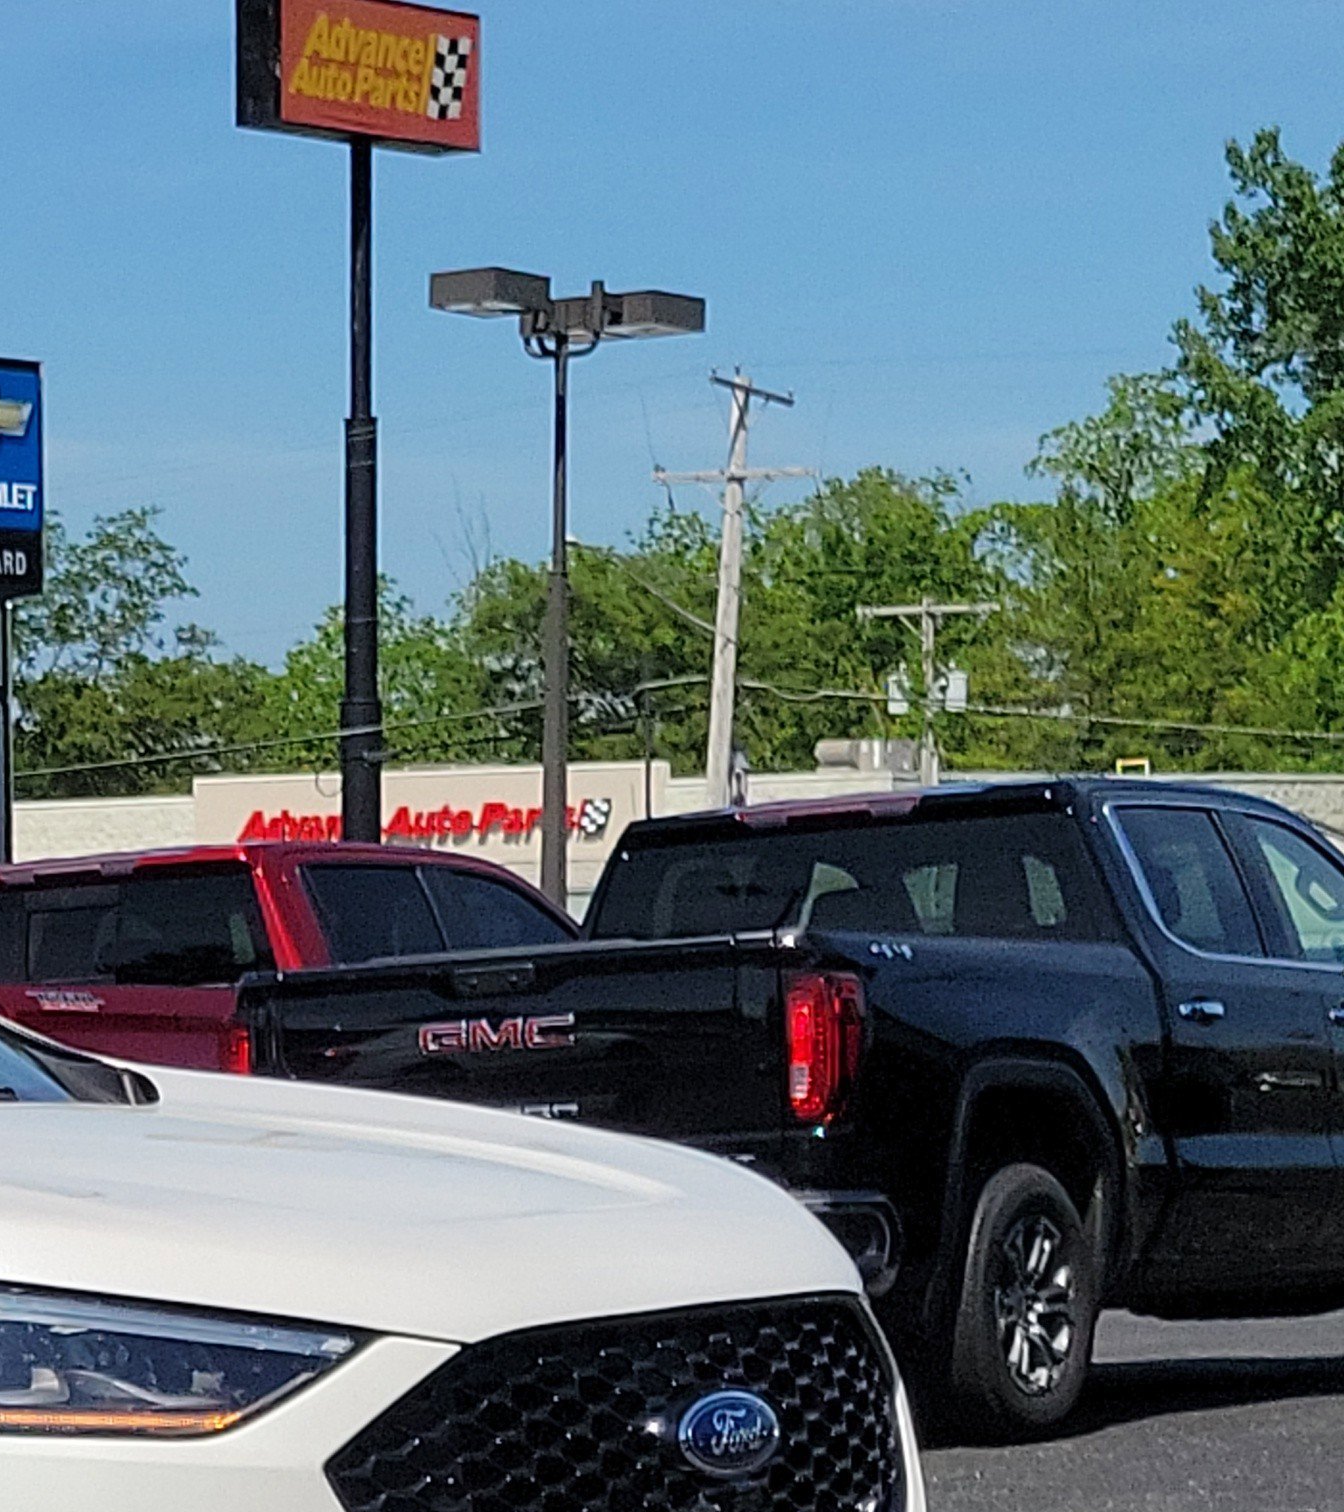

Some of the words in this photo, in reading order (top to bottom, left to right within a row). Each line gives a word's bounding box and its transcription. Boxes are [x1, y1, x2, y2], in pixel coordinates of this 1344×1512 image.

[303, 11, 426, 75] Advance
[289, 59, 353, 101] Auto
[354, 65, 421, 113] Parts
[238, 809, 343, 842] Advan
[382, 805, 473, 837] Auto
[477, 802, 577, 834] Pars
[418, 1012, 577, 1055] GMC
[710, 1408, 767, 1456] Ford
